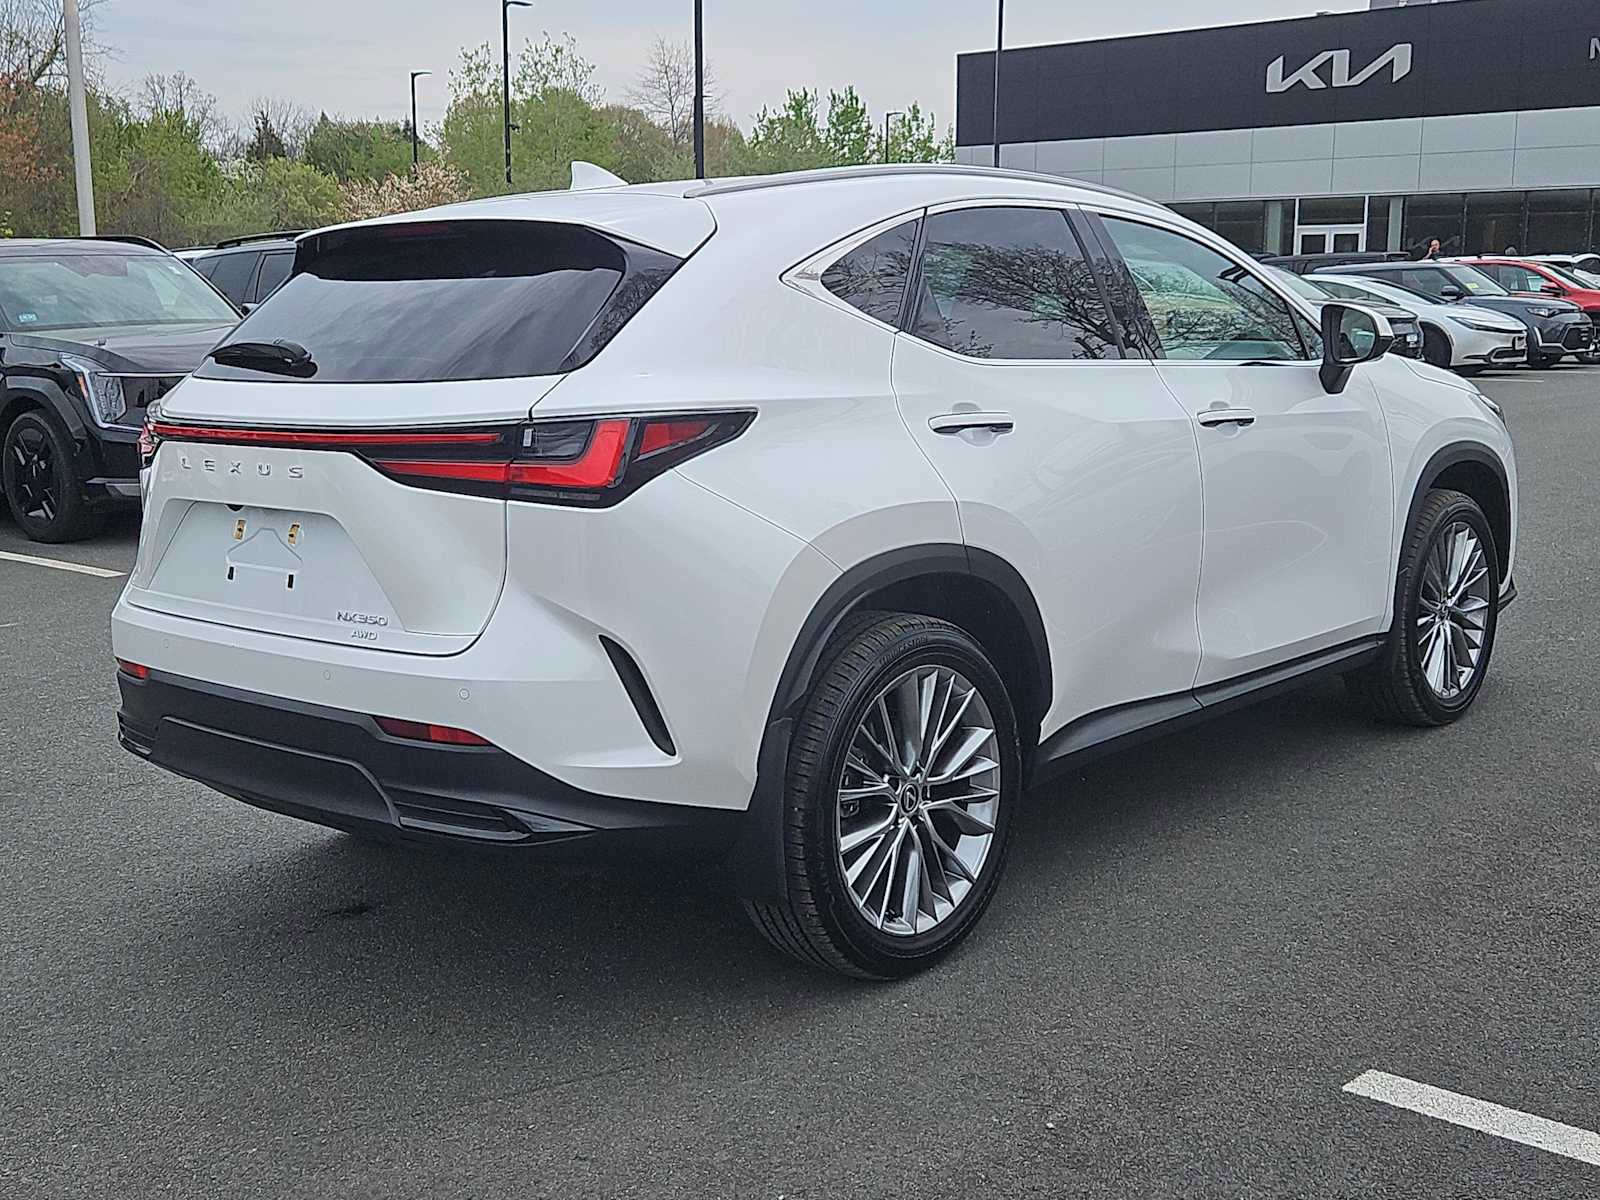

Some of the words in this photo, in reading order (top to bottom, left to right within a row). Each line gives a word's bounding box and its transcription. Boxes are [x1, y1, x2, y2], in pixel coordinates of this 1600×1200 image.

[1265, 43, 1412, 93] KIA
[181, 457, 304, 479] LEXUS
[351, 630, 378, 641] AWD
